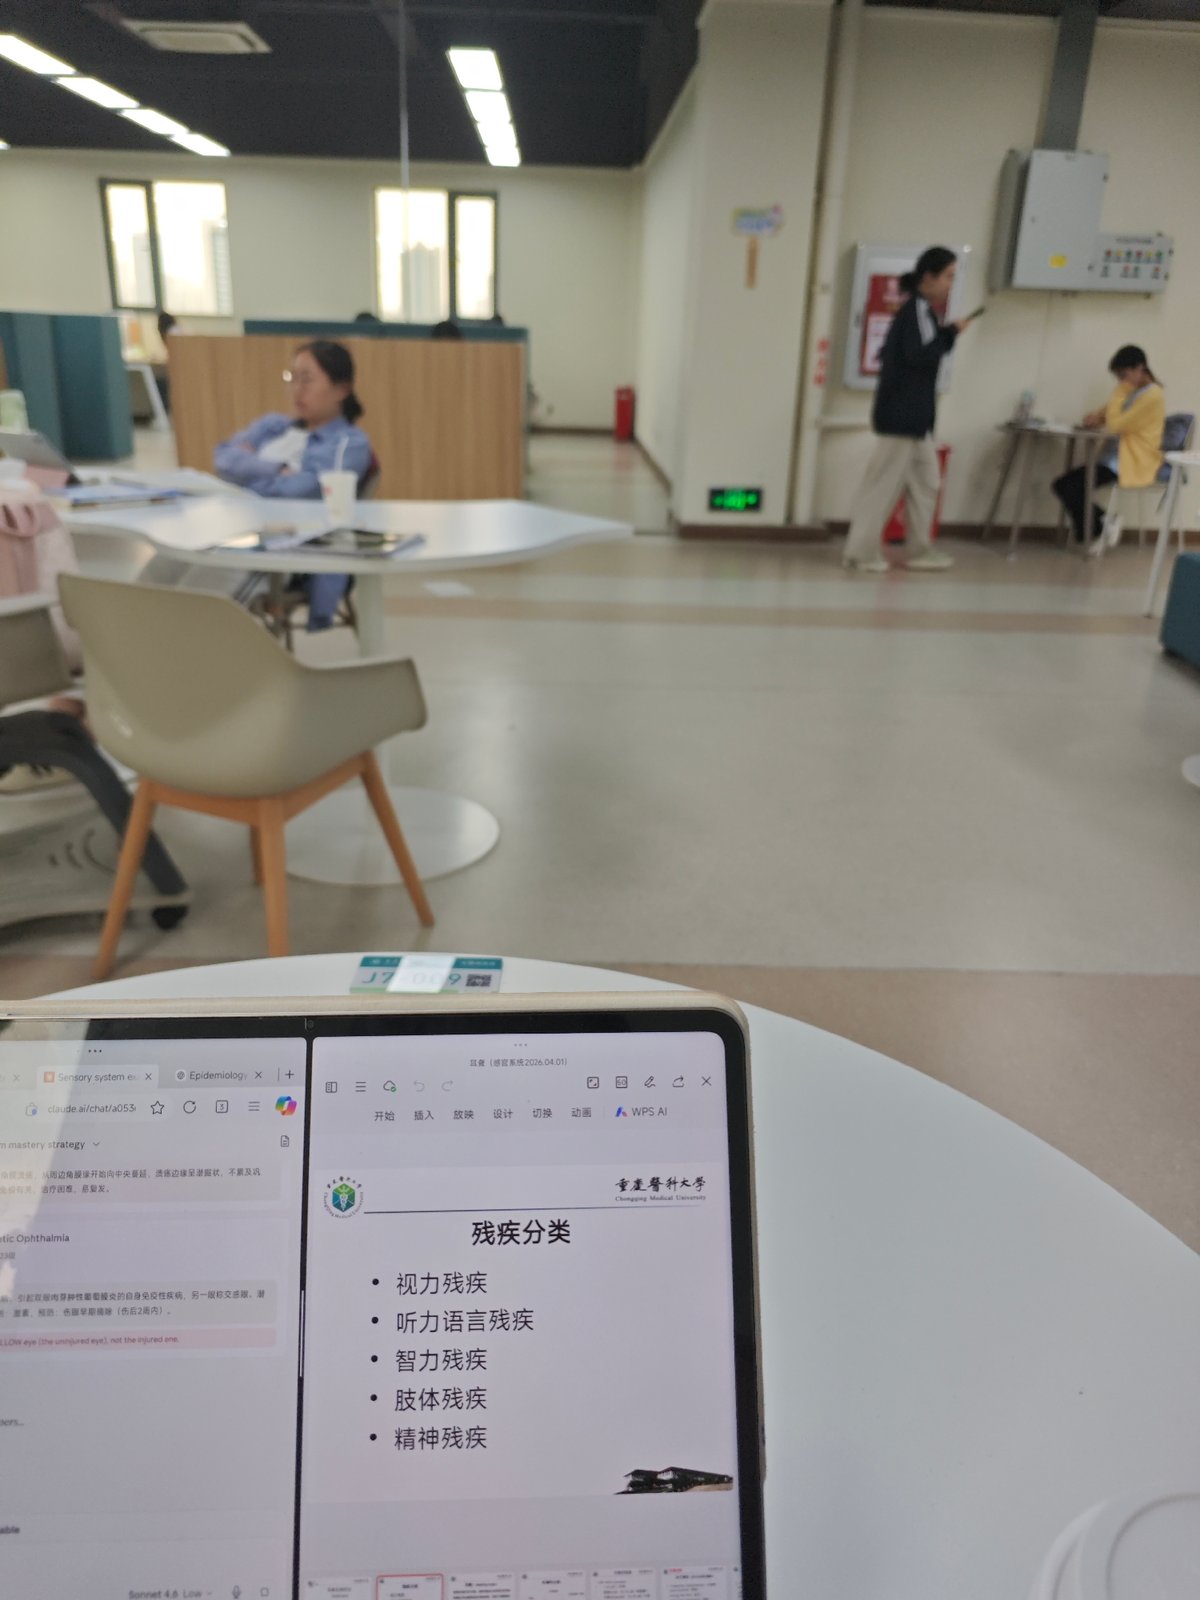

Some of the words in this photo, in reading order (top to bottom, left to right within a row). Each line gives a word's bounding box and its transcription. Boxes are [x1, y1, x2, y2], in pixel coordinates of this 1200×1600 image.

[58, 1073, 92, 1083] Sensory
[95, 1073, 125, 1083] system
[189, 1070, 248, 1081] Epidemiology
[374, 1110, 395, 1122] 开始
[414, 1109, 435, 1121] 插入
[453, 1108, 475, 1120] 放映
[493, 1108, 513, 1120] 设计
[532, 1107, 553, 1119] 切换
[571, 1107, 592, 1119] 动画
[631, 1106, 655, 1117] WPS
[657, 1106, 667, 1117] AI
[8, 1139, 45, 1150] mastery
[48, 1138, 85, 1150] strategy
[471, 1219, 571, 1246] 残疾分类
[16, 1234, 70, 1244] Ophthalmia
[396, 1271, 488, 1296] 视力残疾
[396, 1308, 535, 1334] 听力语言残疾
[110, 1336, 122, 1344] not
[124, 1336, 136, 1344] the
[138, 1335, 163, 1345] injured
[395, 1348, 488, 1373] 智力残疾
[394, 1386, 488, 1412] 肢体残疾
[394, 1425, 488, 1451] 精神残疾
[128, 1589, 161, 1600] Sonnet
[183, 1588, 202, 1599] Low
